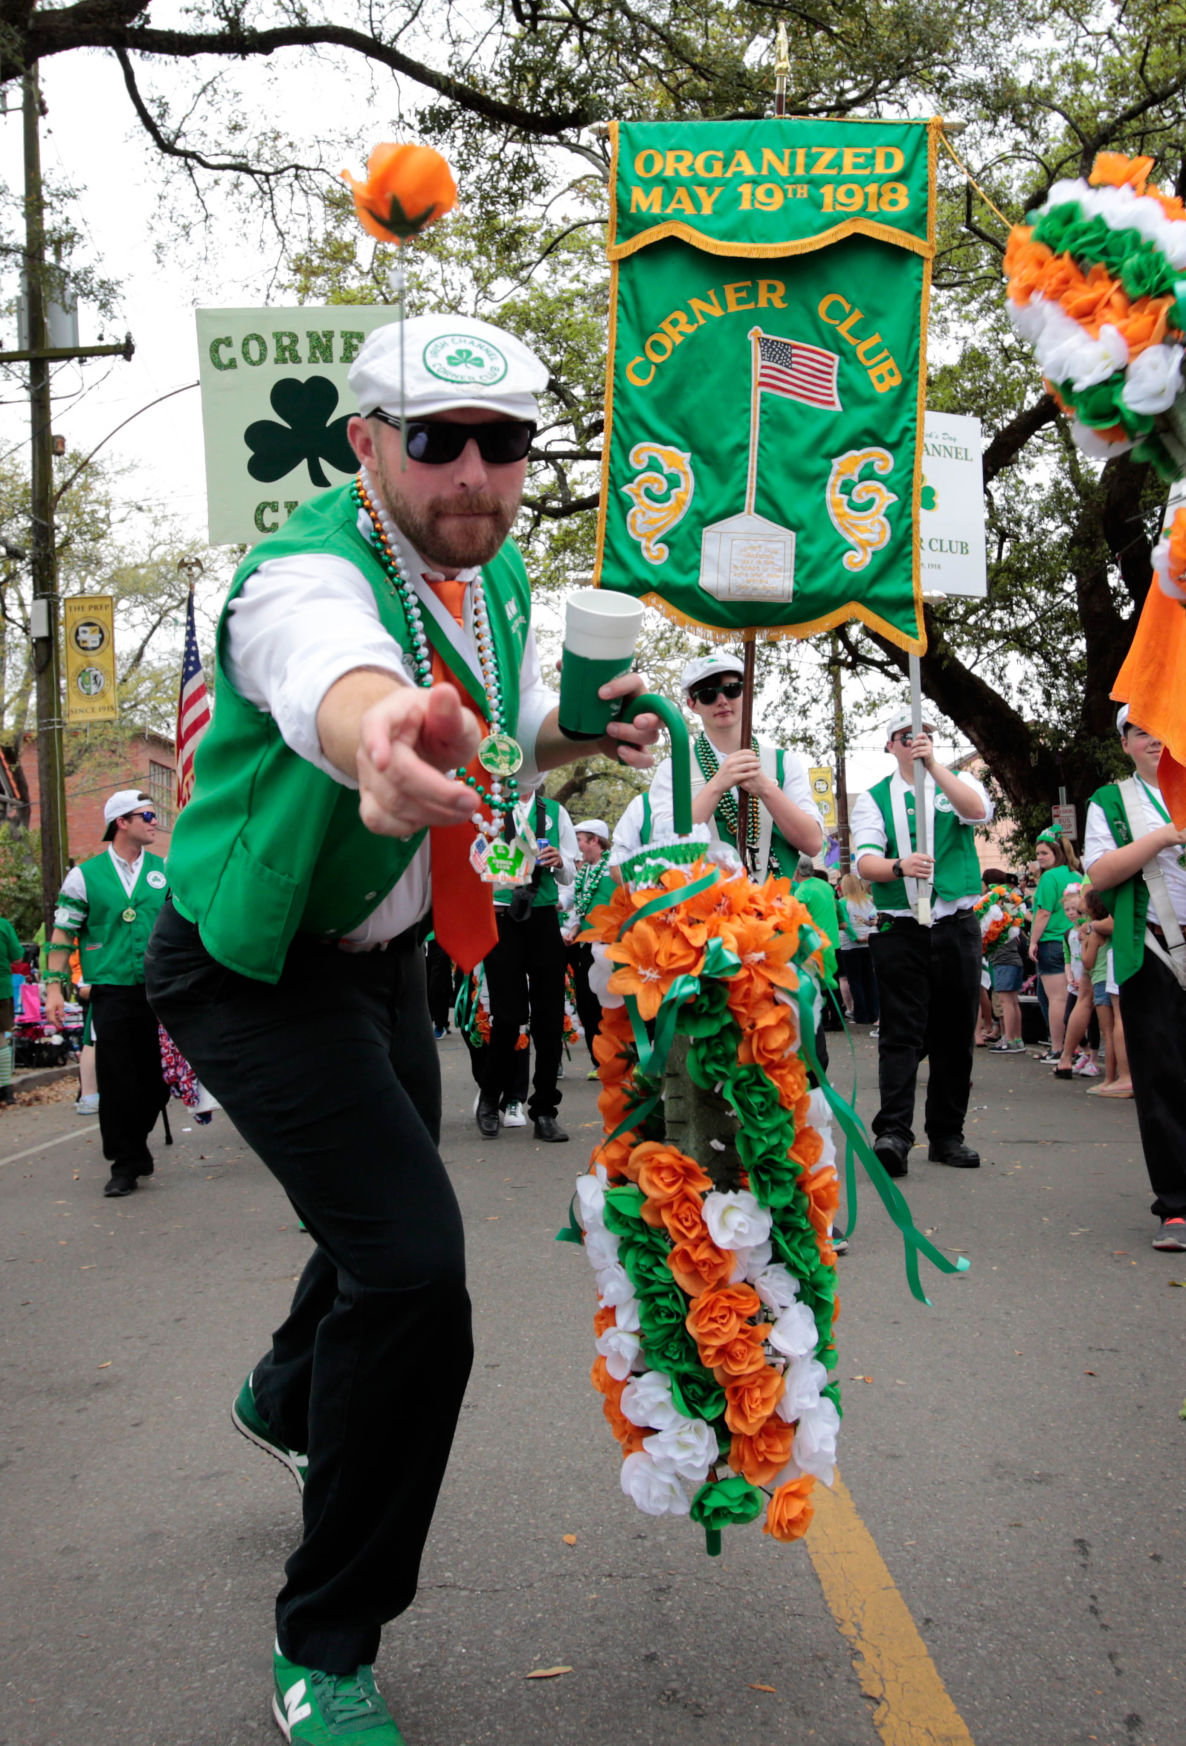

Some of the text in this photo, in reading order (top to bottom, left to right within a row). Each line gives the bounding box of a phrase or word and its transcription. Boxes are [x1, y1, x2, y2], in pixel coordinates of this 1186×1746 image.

[633, 146, 905, 178] ORGANIZED
[629, 181, 910, 215] MAY 19TH 1918
[209, 330, 365, 371] CORNE
[451, 337, 498, 361] CHANNEL
[626, 279, 903, 393] CORNER CLUB
[924, 442, 974, 462] ANNEL
[928, 537, 969, 555] CLUB
